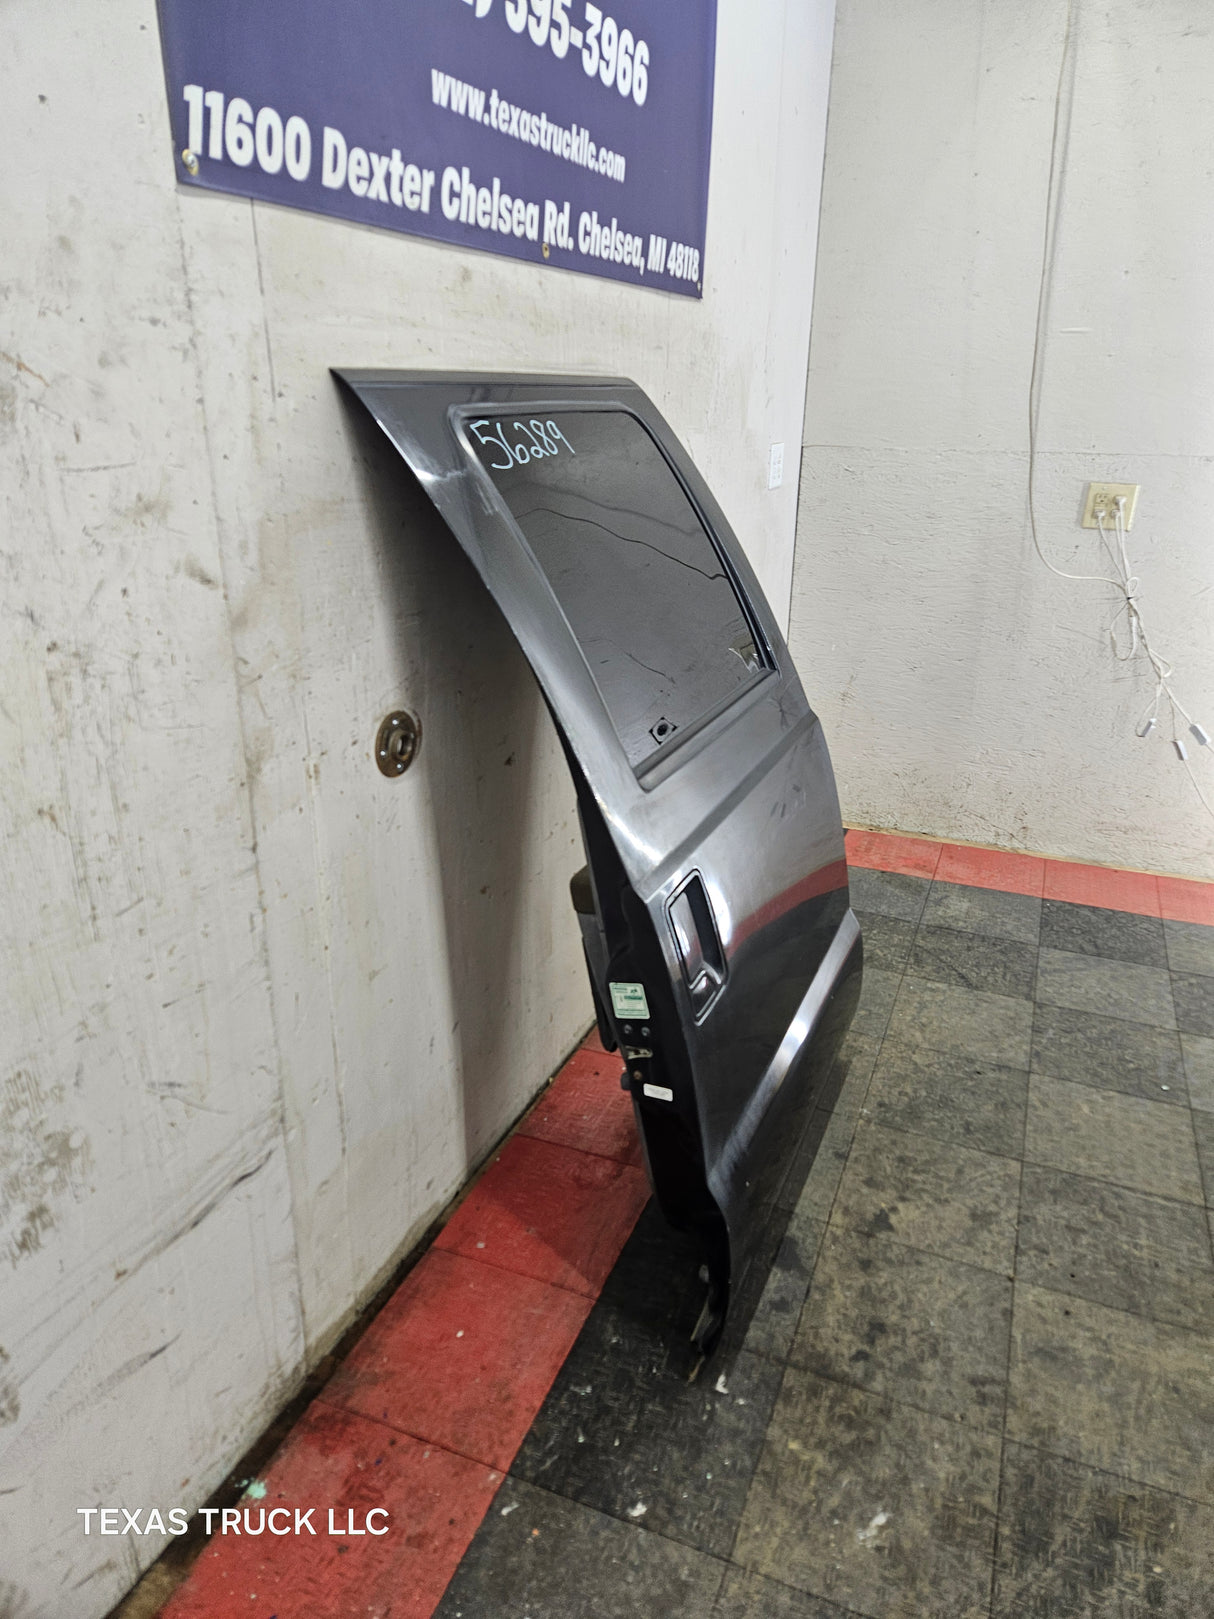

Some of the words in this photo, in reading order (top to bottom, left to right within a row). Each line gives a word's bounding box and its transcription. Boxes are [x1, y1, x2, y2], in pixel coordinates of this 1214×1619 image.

[431, 68, 626, 183] www.texastruckllc.com
[183, 84, 311, 182] 11600
[322, 126, 435, 215] Dexter
[441, 166, 540, 242] Chelsea
[543, 199, 574, 251] Rd.
[578, 211, 645, 276] Chelsea,
[647, 234, 667, 274] MI
[667, 241, 700, 283] 48118
[469, 419, 577, 470] 56289
